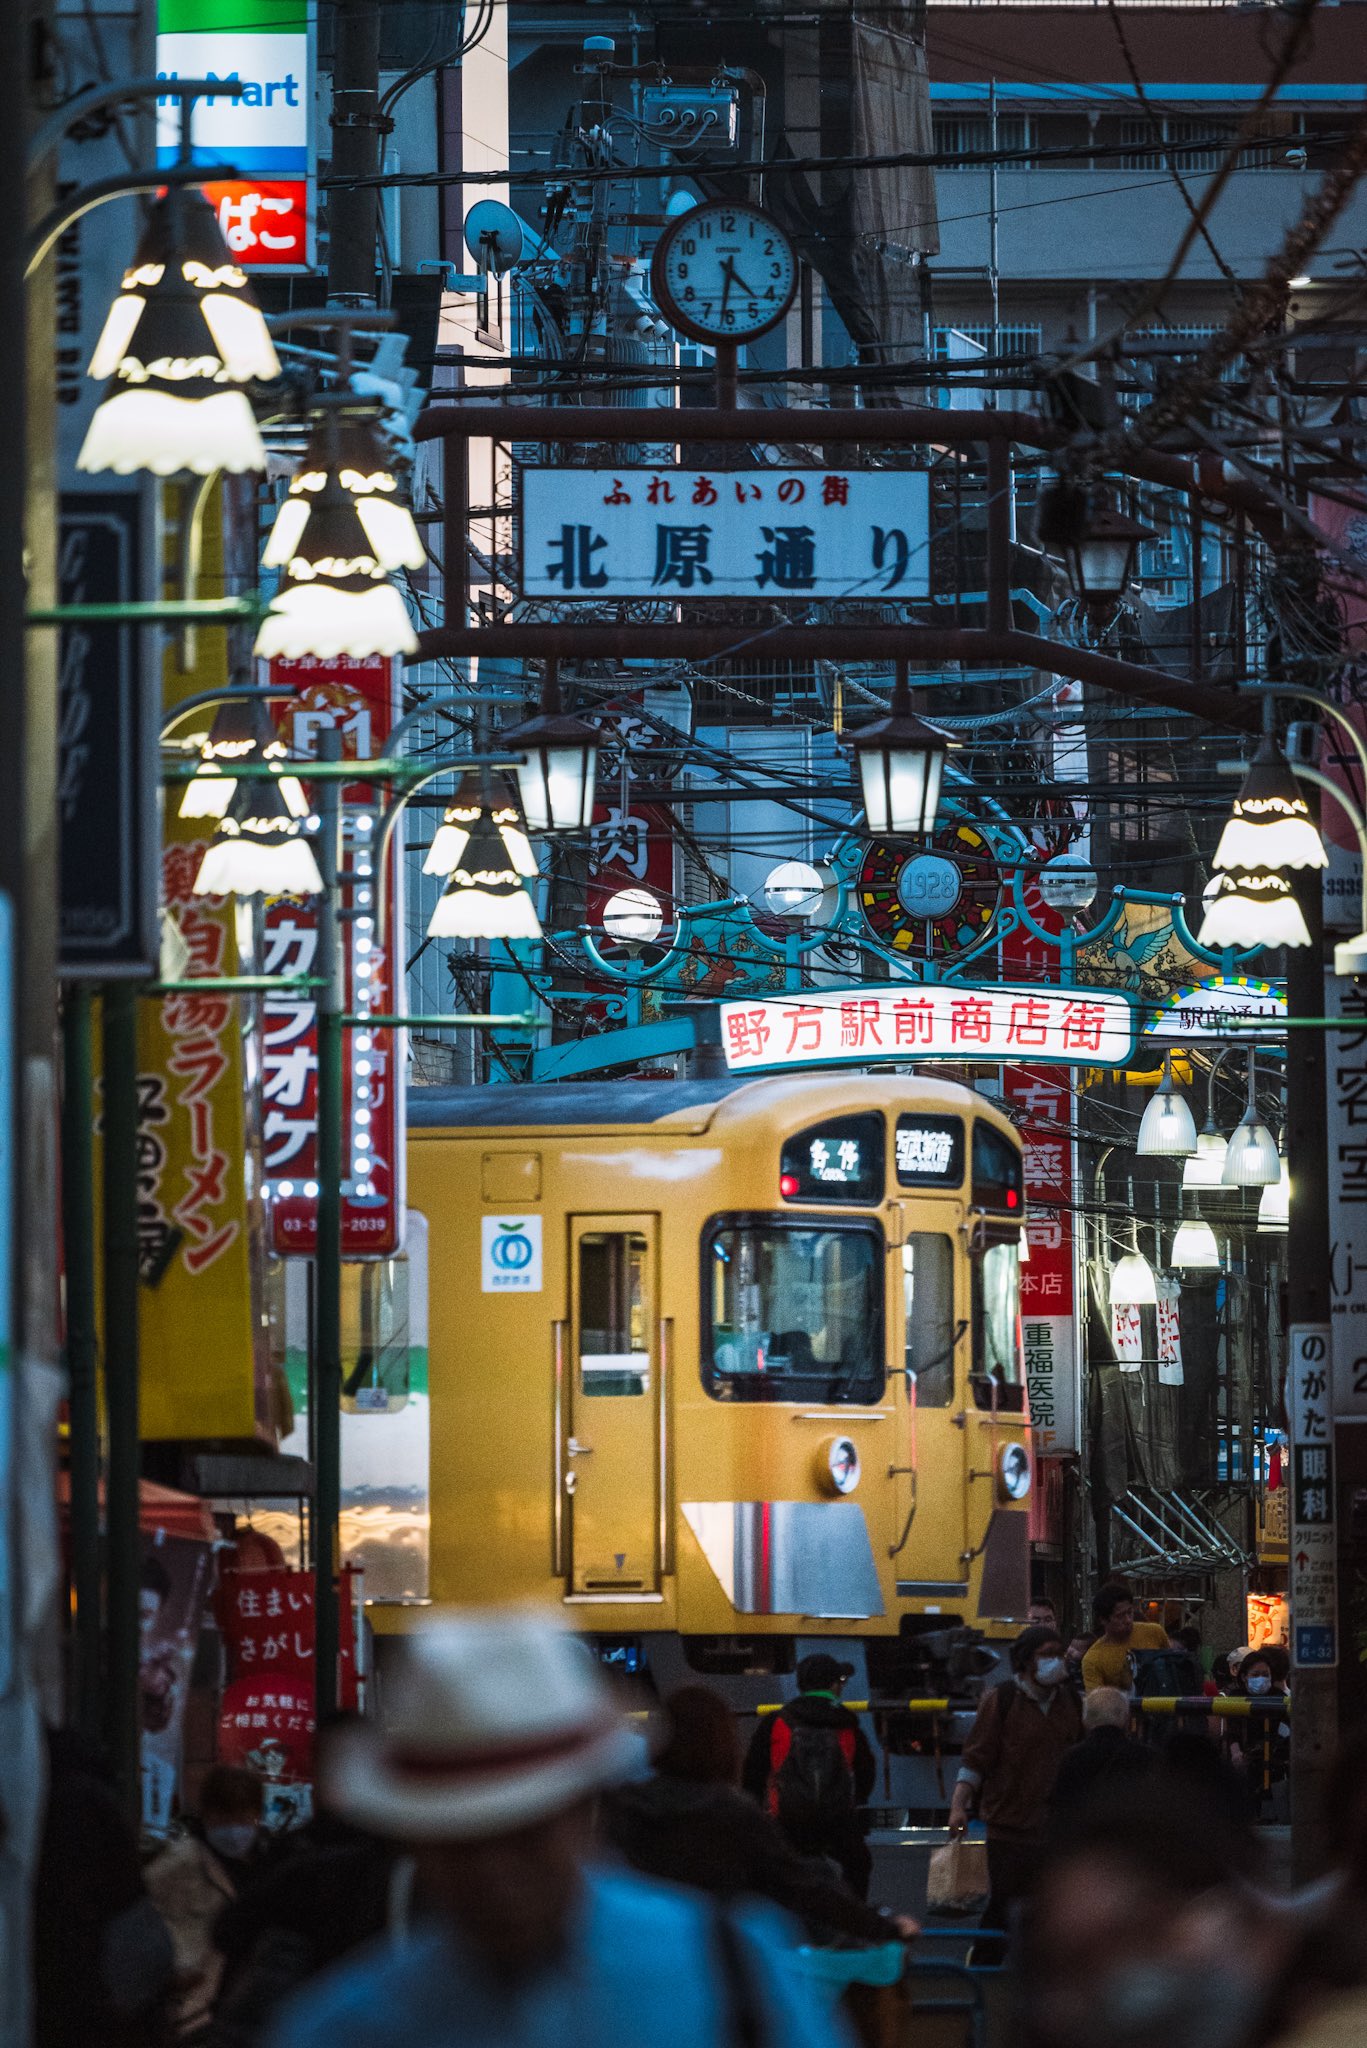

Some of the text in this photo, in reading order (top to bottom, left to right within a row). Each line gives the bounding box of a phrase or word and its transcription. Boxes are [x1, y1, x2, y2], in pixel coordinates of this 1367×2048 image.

[700, 222, 711, 239] 11
[720, 216, 736, 233] 12
[749, 221, 755, 238] 1
[681, 239, 696, 256] 10
[763, 239, 774, 256] 2
[678, 263, 688, 279] 9
[770, 262, 782, 279] 3
[684, 286, 695, 302] 8
[763, 285, 775, 301] 4
[701, 303, 713, 320] 7
[724, 309, 736, 325] 6
[747, 303, 759, 319] 5
[603, 476, 851, 508] ふれあいの街
[545, 524, 911, 593] 北原通り
[902, 871, 956, 901] 1928
[727, 996, 1106, 1060] 野方駅前商店街
[263, 919, 319, 1170] カラオケ
[283, 1217, 387, 1232] 03-3-2039
[1018, 1272, 1063, 1295] 本店
[1024, 1322, 1055, 1428] 重福医院
[238, 1588, 312, 1618] 住まい
